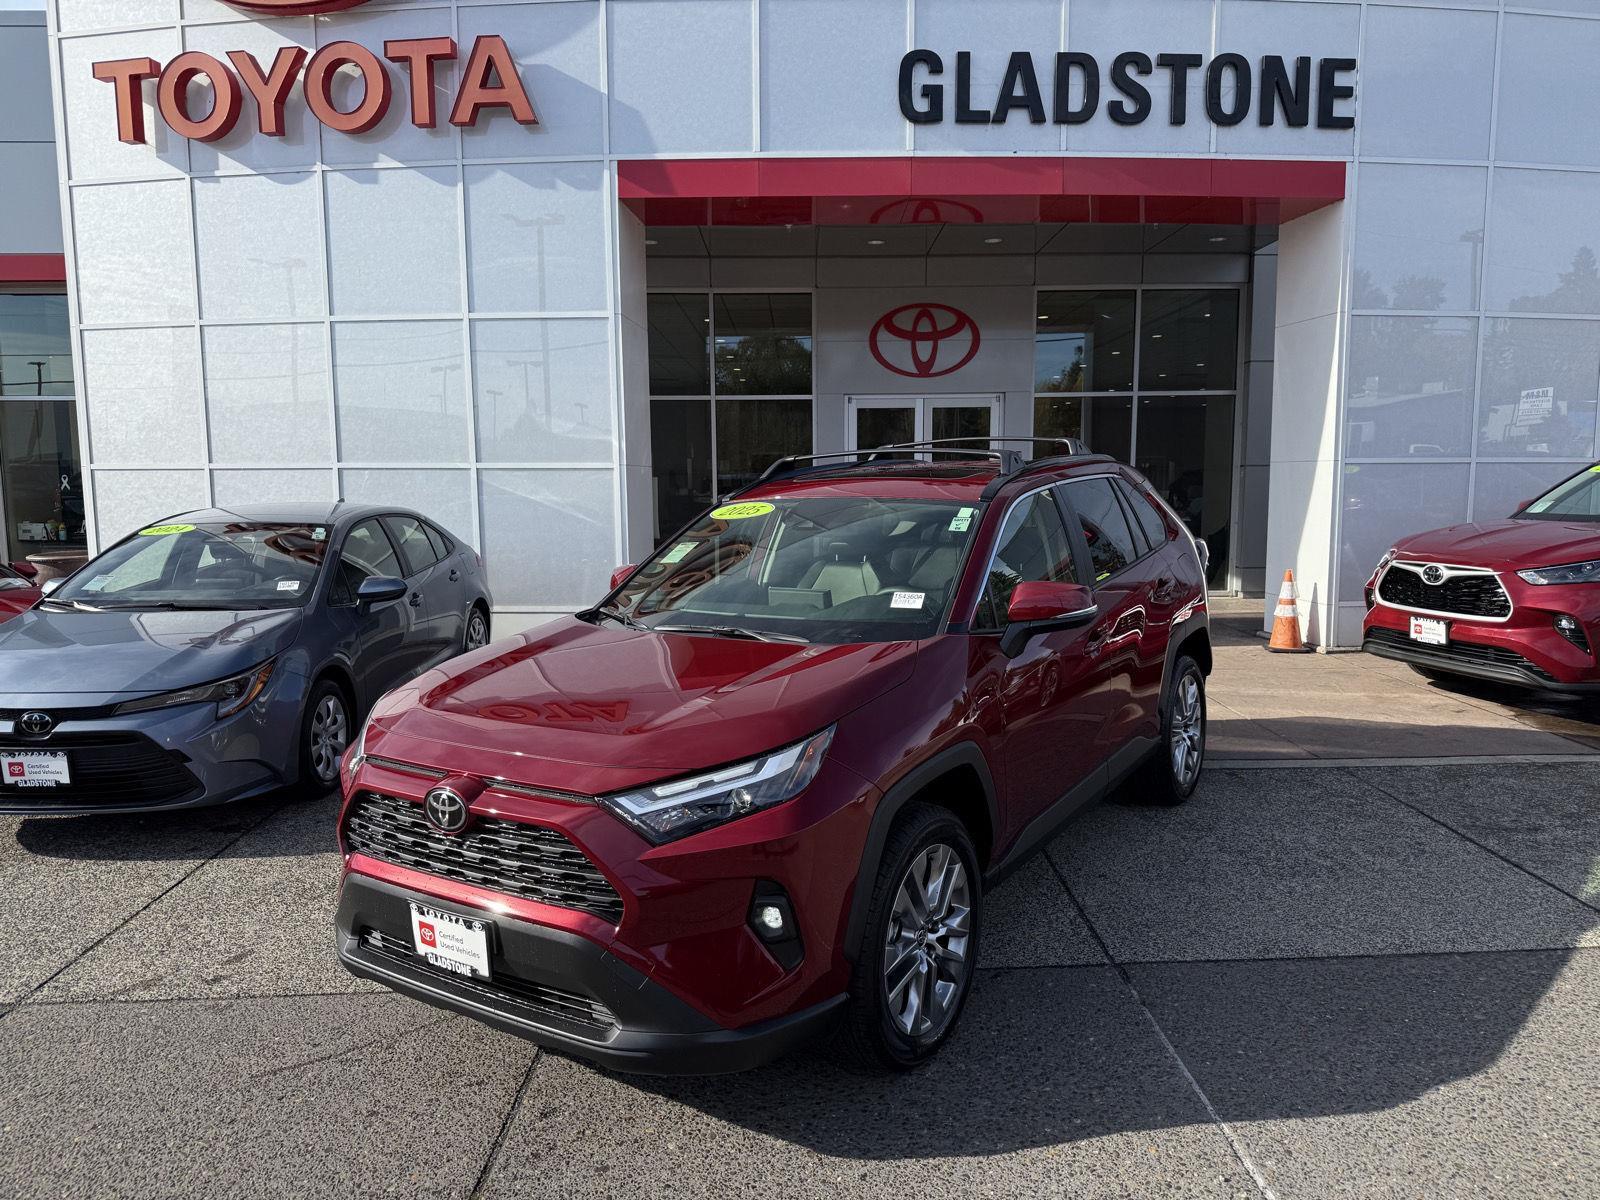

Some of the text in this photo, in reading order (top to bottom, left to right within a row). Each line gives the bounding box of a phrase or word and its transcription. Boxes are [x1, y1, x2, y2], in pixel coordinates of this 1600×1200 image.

[92, 35, 538, 145] TOYOTA
[898, 48, 1357, 129] GLADSTONE
[716, 505, 768, 517] 2025
[18, 779, 56, 787] GLADSTONE
[422, 907, 464, 926] TOYOTA
[438, 930, 464, 945] Certified
[440, 941, 480, 959] Used Vehicles
[427, 953, 472, 977] GLADSTONE
